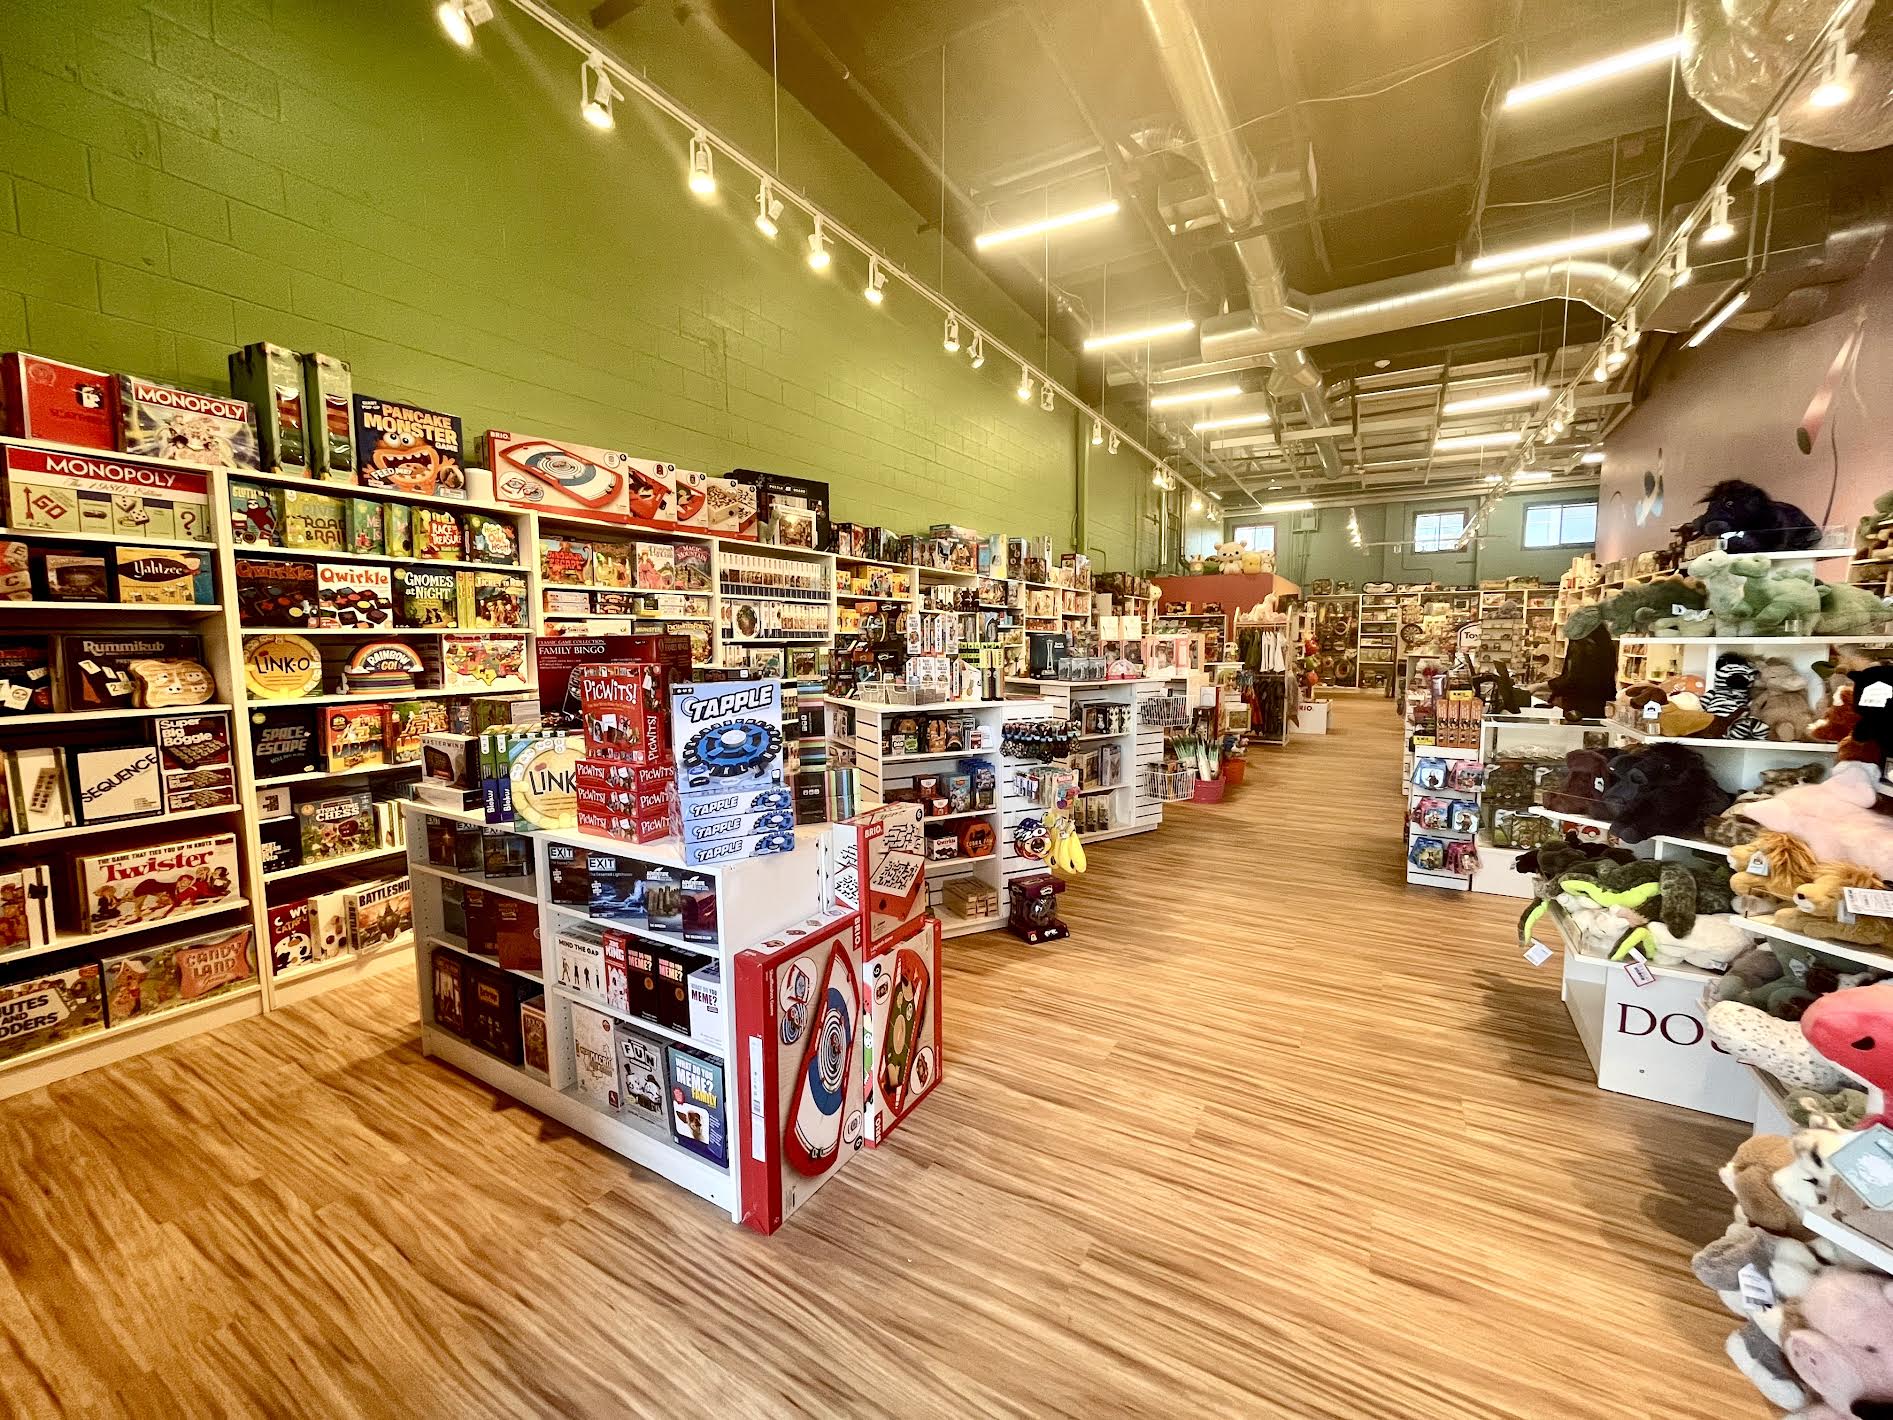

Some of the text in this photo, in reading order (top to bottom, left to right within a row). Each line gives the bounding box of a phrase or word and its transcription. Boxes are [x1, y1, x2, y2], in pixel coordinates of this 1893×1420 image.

[137, 385, 244, 420] MONOPOLY
[382, 404, 452, 430] PANCAKE
[363, 412, 458, 446] MONSTER
[435, 442, 458, 453] GAME
[46, 456, 176, 487] MONOPOLY
[370, 468, 395, 480] FEED
[31, 493, 68, 521] GO
[432, 524, 453, 535] RACE
[677, 551, 707, 562] MOUNTAIN
[134, 561, 183, 579] Yahtzee
[236, 561, 315, 580] Qwirkle
[320, 568, 388, 584] Qwirkle
[404, 571, 454, 587] GNOMES
[82, 640, 165, 656] Rummikub
[539, 646, 605, 655] FAMILY BINGO
[255, 656, 310, 674] LINK-O
[366, 650, 411, 667] RAINBOW
[691, 684, 774, 723] TAPPLE
[160, 718, 201, 729] Super
[162, 728, 185, 738] Big
[163, 733, 212, 746] Boggle
[261, 726, 305, 742] SPACE
[256, 739, 308, 756] ESCAPE
[81, 753, 158, 803] SEQUENCE
[316, 808, 360, 822] CHESS
[693, 796, 739, 817] TAPPLE
[696, 818, 741, 839] TAPPLE
[864, 825, 882, 838] BRIO
[98, 858, 110, 866] THE
[112, 855, 130, 863] GAME
[132, 852, 147, 860] THAT
[149, 849, 162, 857] TIES
[164, 847, 176, 855] YOU
[194, 841, 212, 849] KNOTS
[551, 848, 573, 859] EXIT
[696, 840, 743, 862] TAPPLE
[100, 851, 213, 882] Twister
[589, 858, 615, 870] EXIT
[186, 942, 242, 968] CANDY
[559, 939, 599, 957] MIND THE GAP
[192, 956, 237, 977] LAND
[628, 955, 653, 972] MEME?
[659, 965, 683, 982] MEME?
[692, 990, 718, 1006] MEME?
[1, 1012, 28, 1025] AND
[1617, 1002, 1730, 1055] DO
[624, 1044, 655, 1067] FUN
[676, 1057, 713, 1080] WHAT DO YOU
[676, 1066, 714, 1094] MEME?
[692, 1088, 717, 1108] FAMILY
